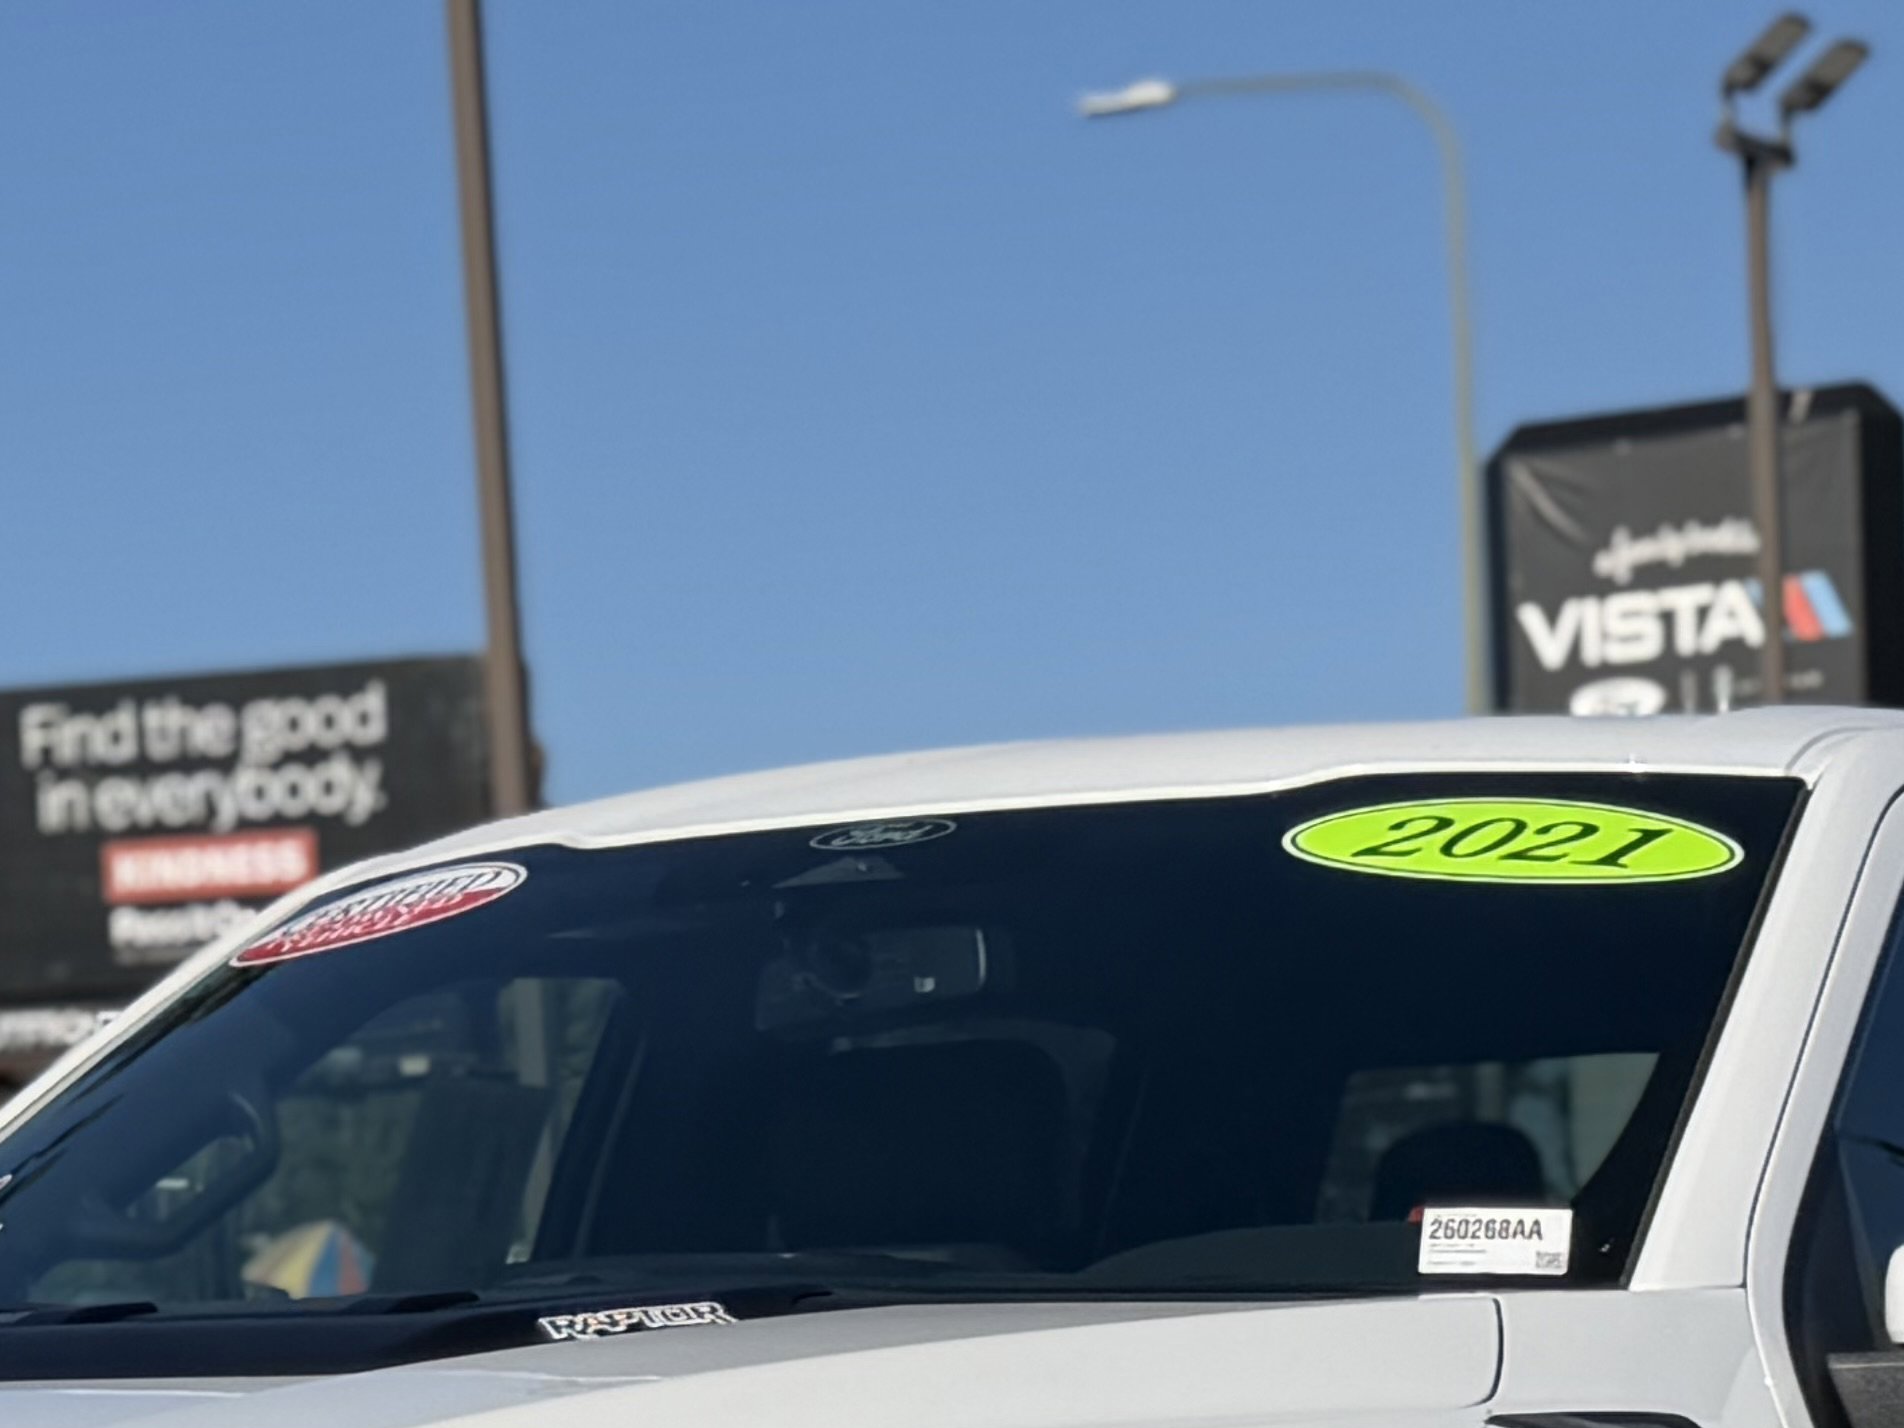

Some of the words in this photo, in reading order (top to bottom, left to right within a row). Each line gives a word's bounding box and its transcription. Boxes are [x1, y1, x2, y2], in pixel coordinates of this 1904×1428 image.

[1517, 579, 1766, 672] VISTA
[20, 698, 138, 769] Find
[142, 694, 236, 761] the
[241, 680, 388, 767] good
[36, 768, 92, 833] in
[1352, 814, 1673, 870] 2021
[537, 1301, 740, 1340] RAPTOR
